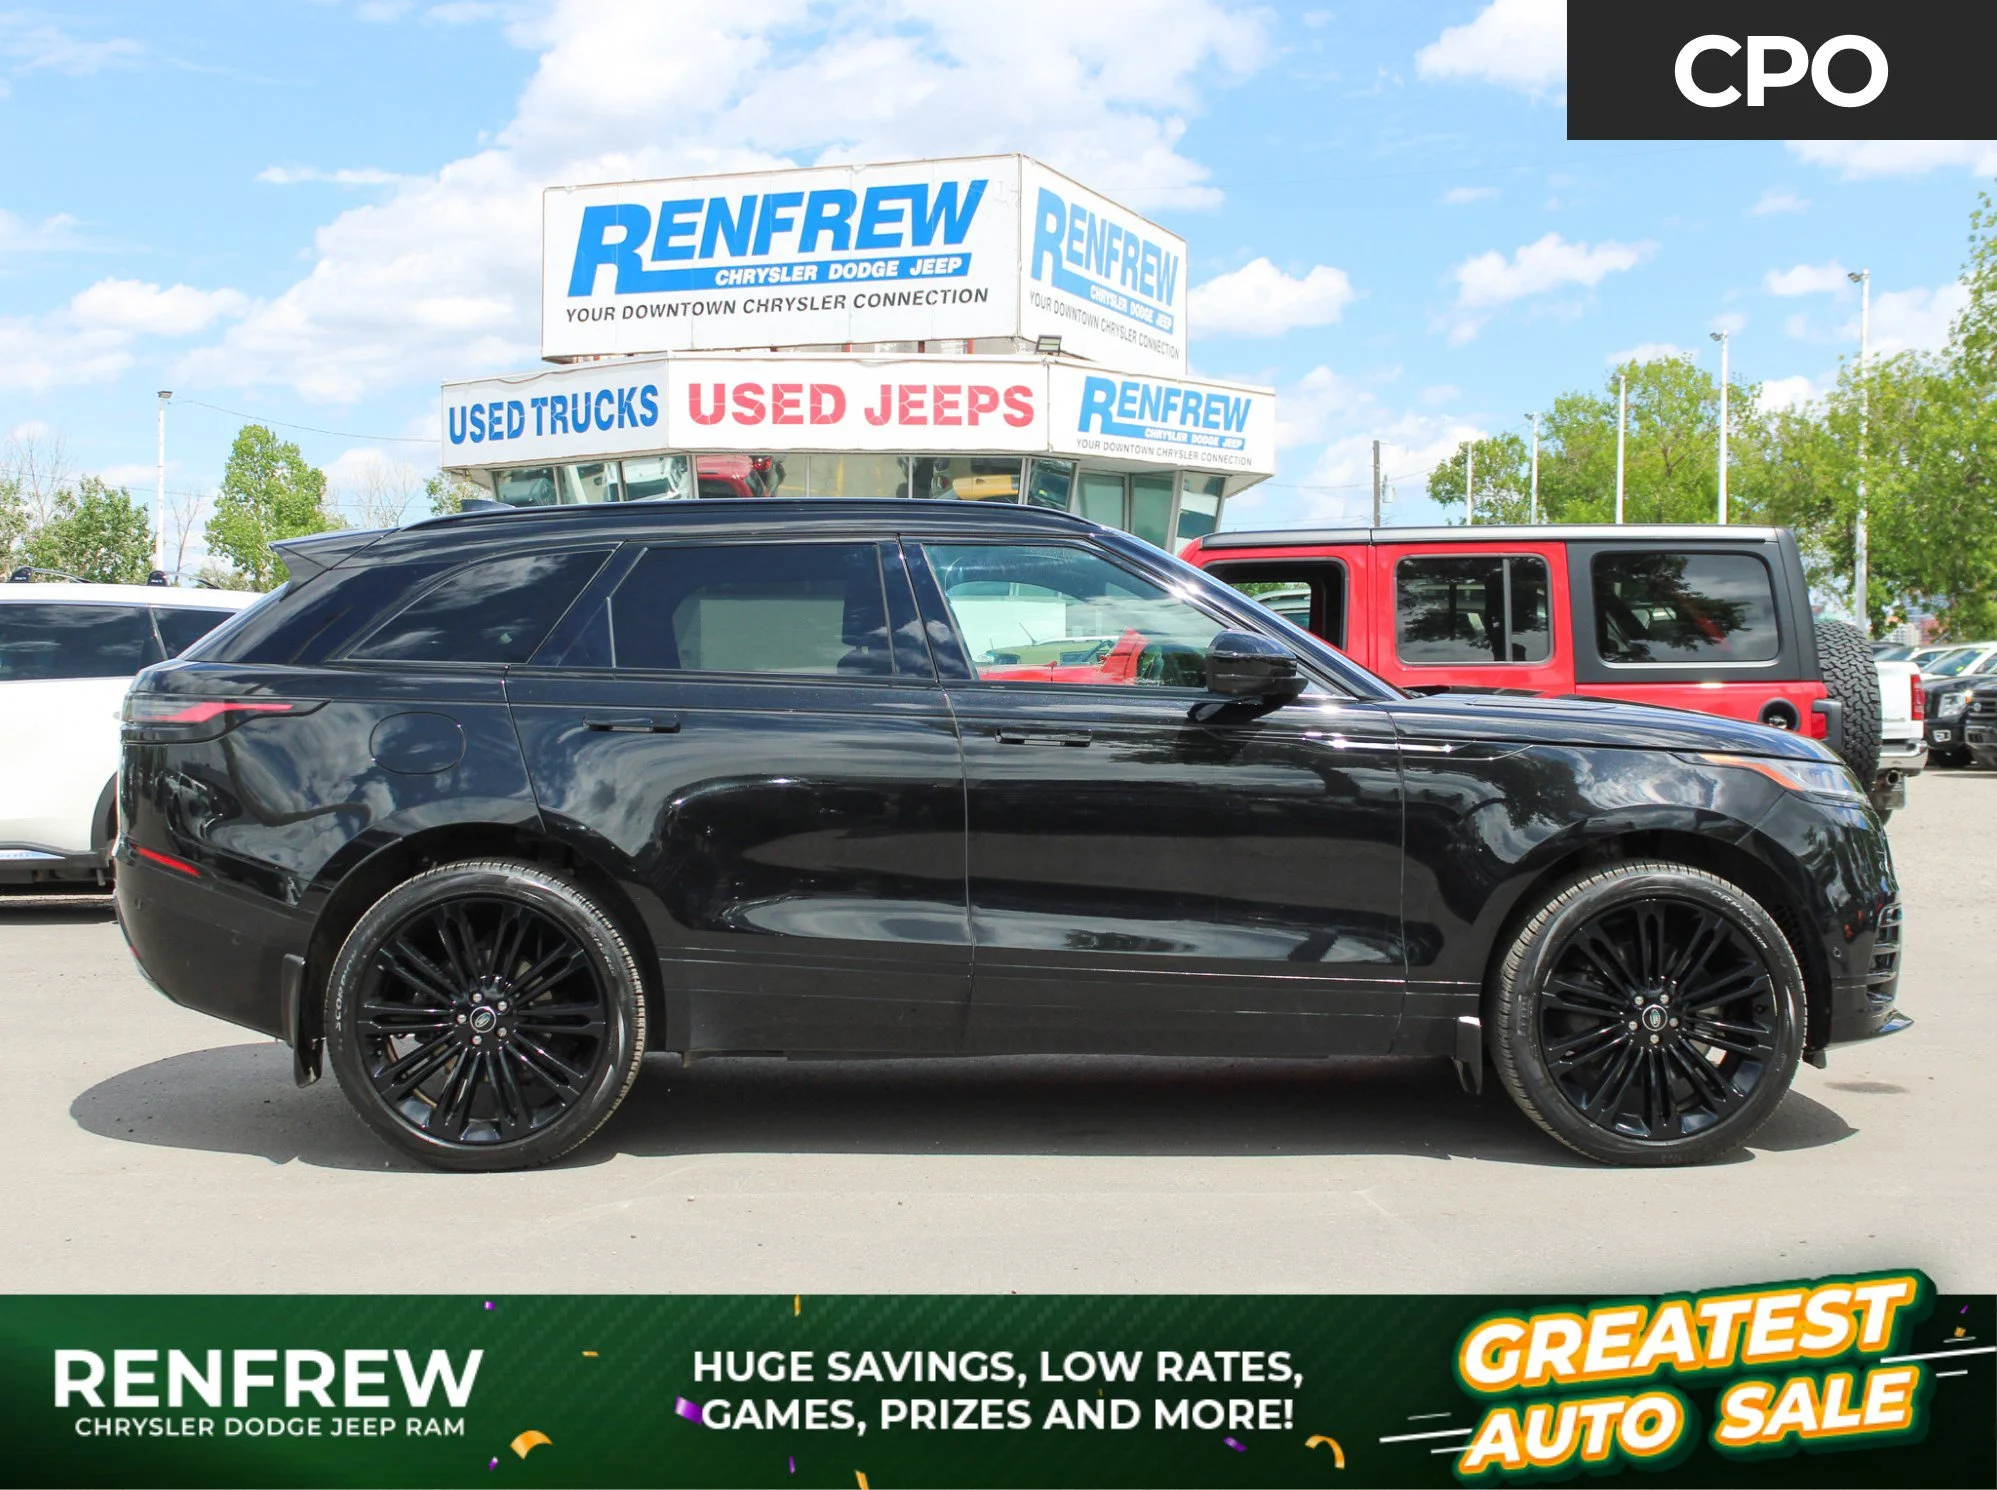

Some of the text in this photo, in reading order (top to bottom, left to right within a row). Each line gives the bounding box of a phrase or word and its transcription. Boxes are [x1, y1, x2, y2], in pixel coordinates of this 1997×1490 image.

[567, 179, 989, 298] RENFREW
[1030, 186, 1179, 307] RENFREW
[714, 256, 963, 287] CHRYSLER DODGE JEEP
[566, 287, 989, 323] YOUR DOWNTOWN CHRYSLER CONNECTION
[1029, 290, 1180, 360] YOUR DOWNTOWN CHRYSLER CONNECTION
[1090, 284, 1172, 331] CHRYSLER DODGE JEEP
[449, 384, 659, 445] USED TRUCKS
[688, 382, 1035, 428] USED JEEPS
[1077, 375, 1252, 433] RENFREW
[1076, 438, 1252, 466] YOUR DOWNTOWN CHRYSLER CONNECTION
[1144, 427, 1243, 448] CHRYSLER DODGE JEEP
